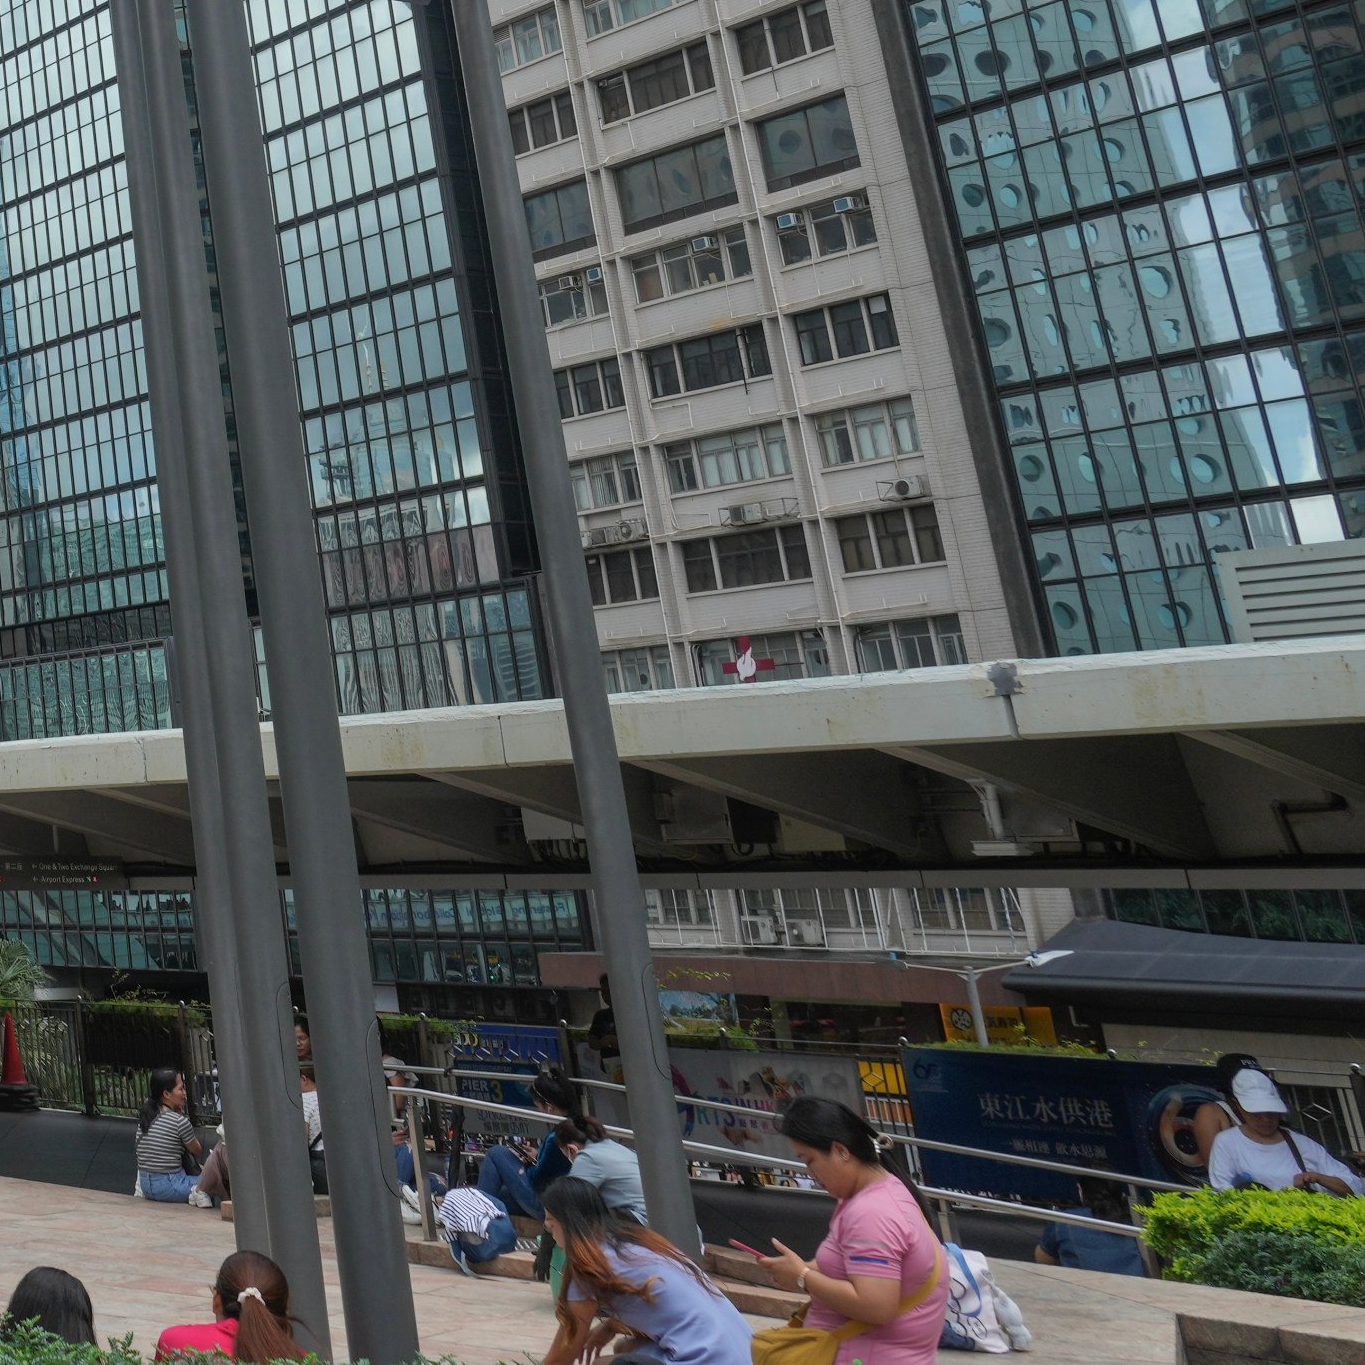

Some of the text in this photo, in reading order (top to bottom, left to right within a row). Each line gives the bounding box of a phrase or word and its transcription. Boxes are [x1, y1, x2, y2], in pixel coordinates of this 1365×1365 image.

[70, 864, 98, 872] Exchange
[40, 876, 85, 884] Airport Express
[462, 1079, 503, 1103] PIER 3
[978, 1092, 1114, 1129] 東江水供港
